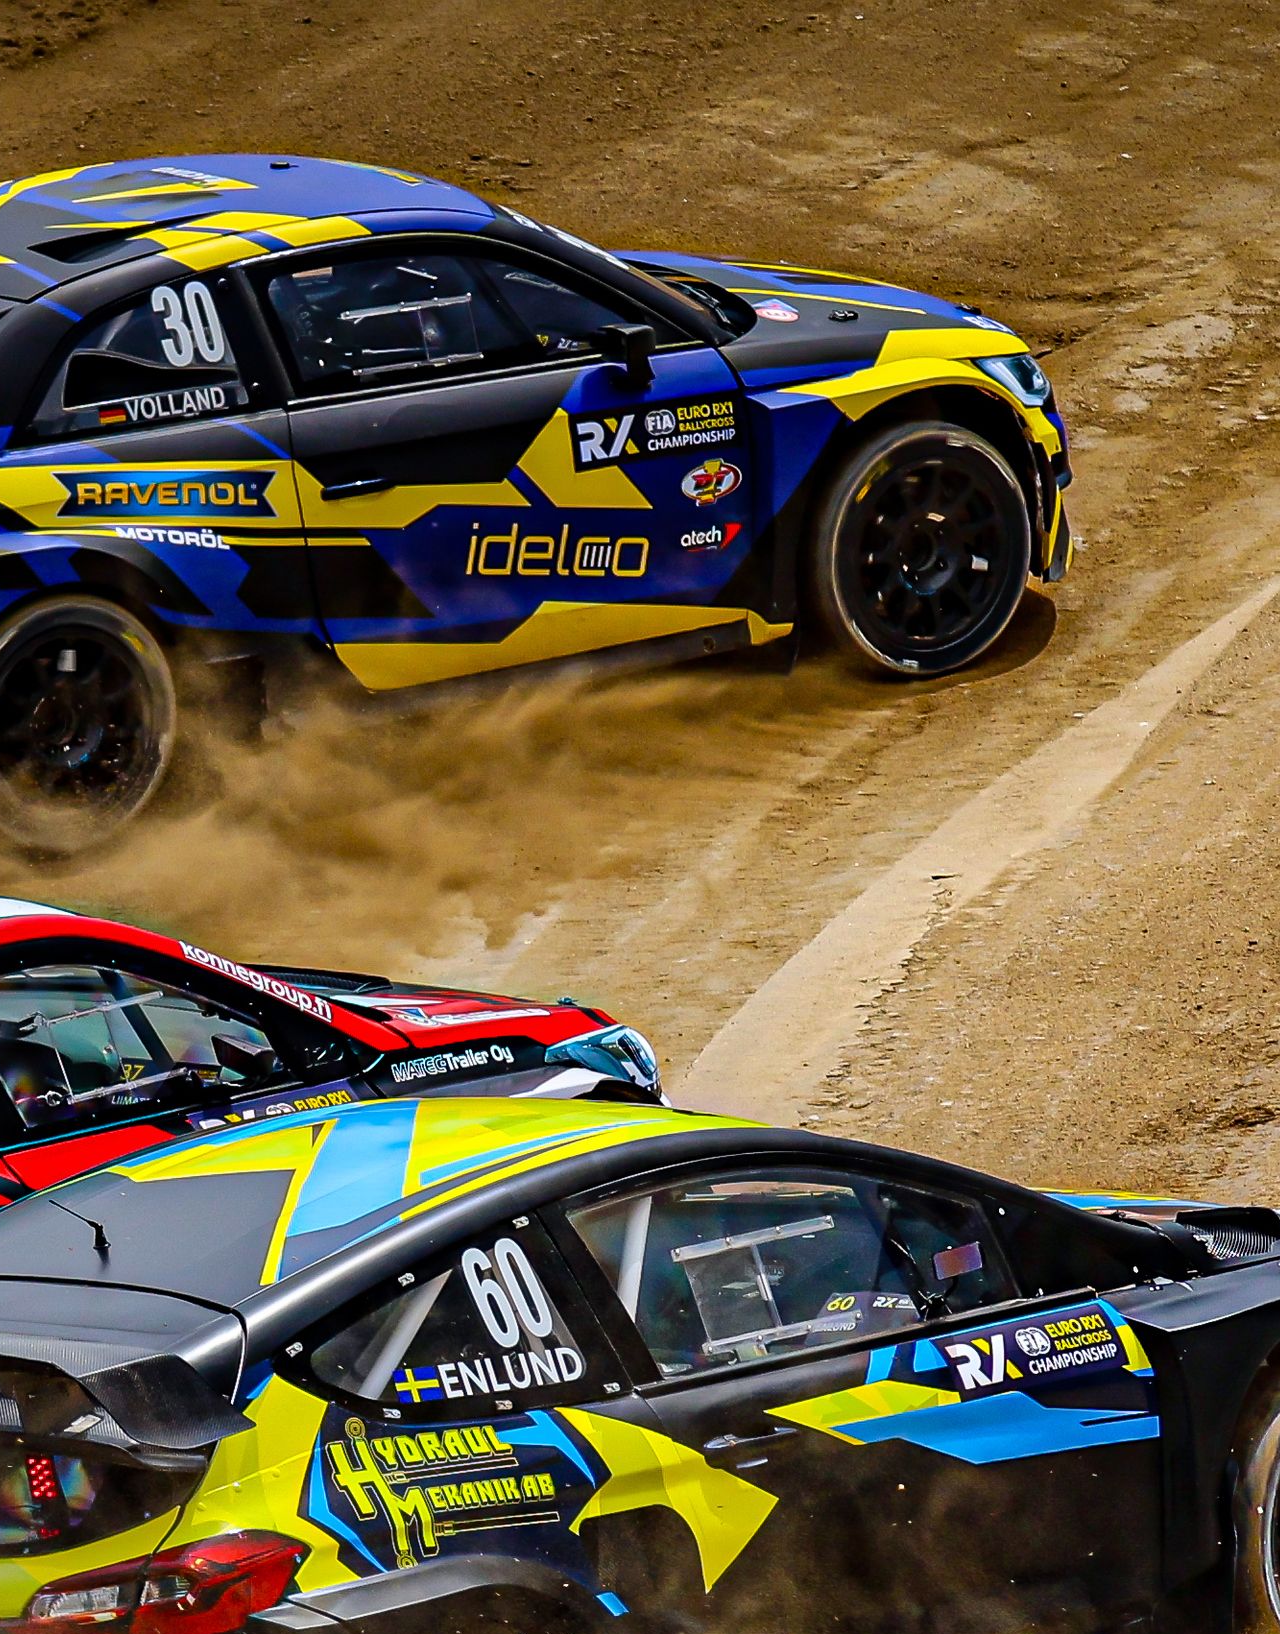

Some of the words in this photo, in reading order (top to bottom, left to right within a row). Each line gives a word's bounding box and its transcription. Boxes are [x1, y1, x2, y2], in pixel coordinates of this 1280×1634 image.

[151, 281, 225, 367] 30
[125, 387, 225, 421] VOLLAND
[677, 403, 710, 421] EURO
[712, 401, 734, 415] RX1
[646, 414, 674, 433] FIA
[679, 416, 735, 432] RALLYCROSS
[576, 414, 640, 463] RX
[647, 428, 736, 451] CHAMPIONSHIP
[76, 482, 258, 506] RAVENOL
[115, 527, 231, 550] MOTORÖL
[681, 525, 722, 547] atech
[179, 940, 333, 1020] konnegroup.fi
[490, 1044, 515, 1064] Oy
[461, 1237, 553, 1348] 60
[827, 1296, 855, 1311] 60
[1044, 1319, 1081, 1339] EURO
[1082, 1314, 1107, 1332] RX1
[1018, 1334, 1049, 1353] FIA
[1054, 1329, 1112, 1351] RALLYCROSS
[945, 1333, 1023, 1390] RX
[1029, 1343, 1118, 1375] CHAMPIONSHIP
[437, 1347, 583, 1399] ENLUND
[326, 1424, 514, 1521] HYDRAUL
[391, 1477, 521, 1557] MEKANIK
[521, 1473, 556, 1502] AB
